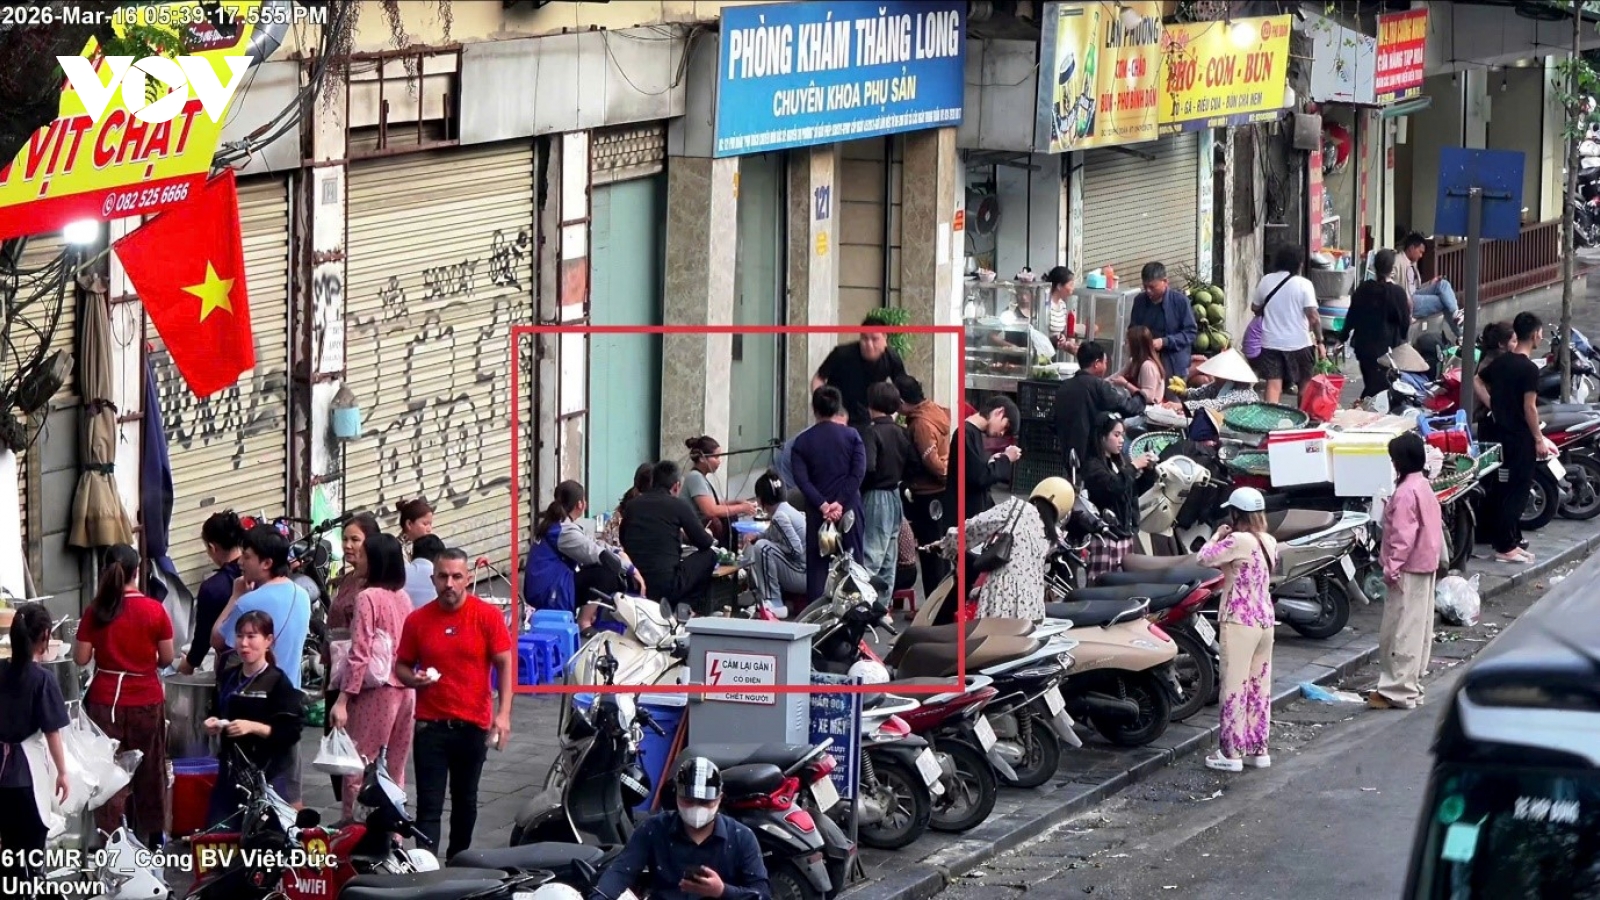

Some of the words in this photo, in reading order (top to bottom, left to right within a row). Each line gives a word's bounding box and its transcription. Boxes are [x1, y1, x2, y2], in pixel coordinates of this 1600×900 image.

[728, 14, 793, 80] PHÒNG
[797, 11, 851, 73] KHÁM
[855, 6, 911, 66] THĂNG
[916, 10, 959, 59] LONG
[1243, 43, 1274, 83] BÚN
[773, 80, 825, 117] CHUYÊN
[827, 82, 861, 112] KHOA
[864, 79, 889, 112] PHỤ
[891, 66, 917, 103] SẢN
[23, 115, 94, 197] VỊT
[115, 191, 139, 212] 082
[138, 187, 161, 207] 525
[161, 182, 190, 204] 6666
[814, 185, 830, 221] 121
[299, 878, 326, 895] WIFI
